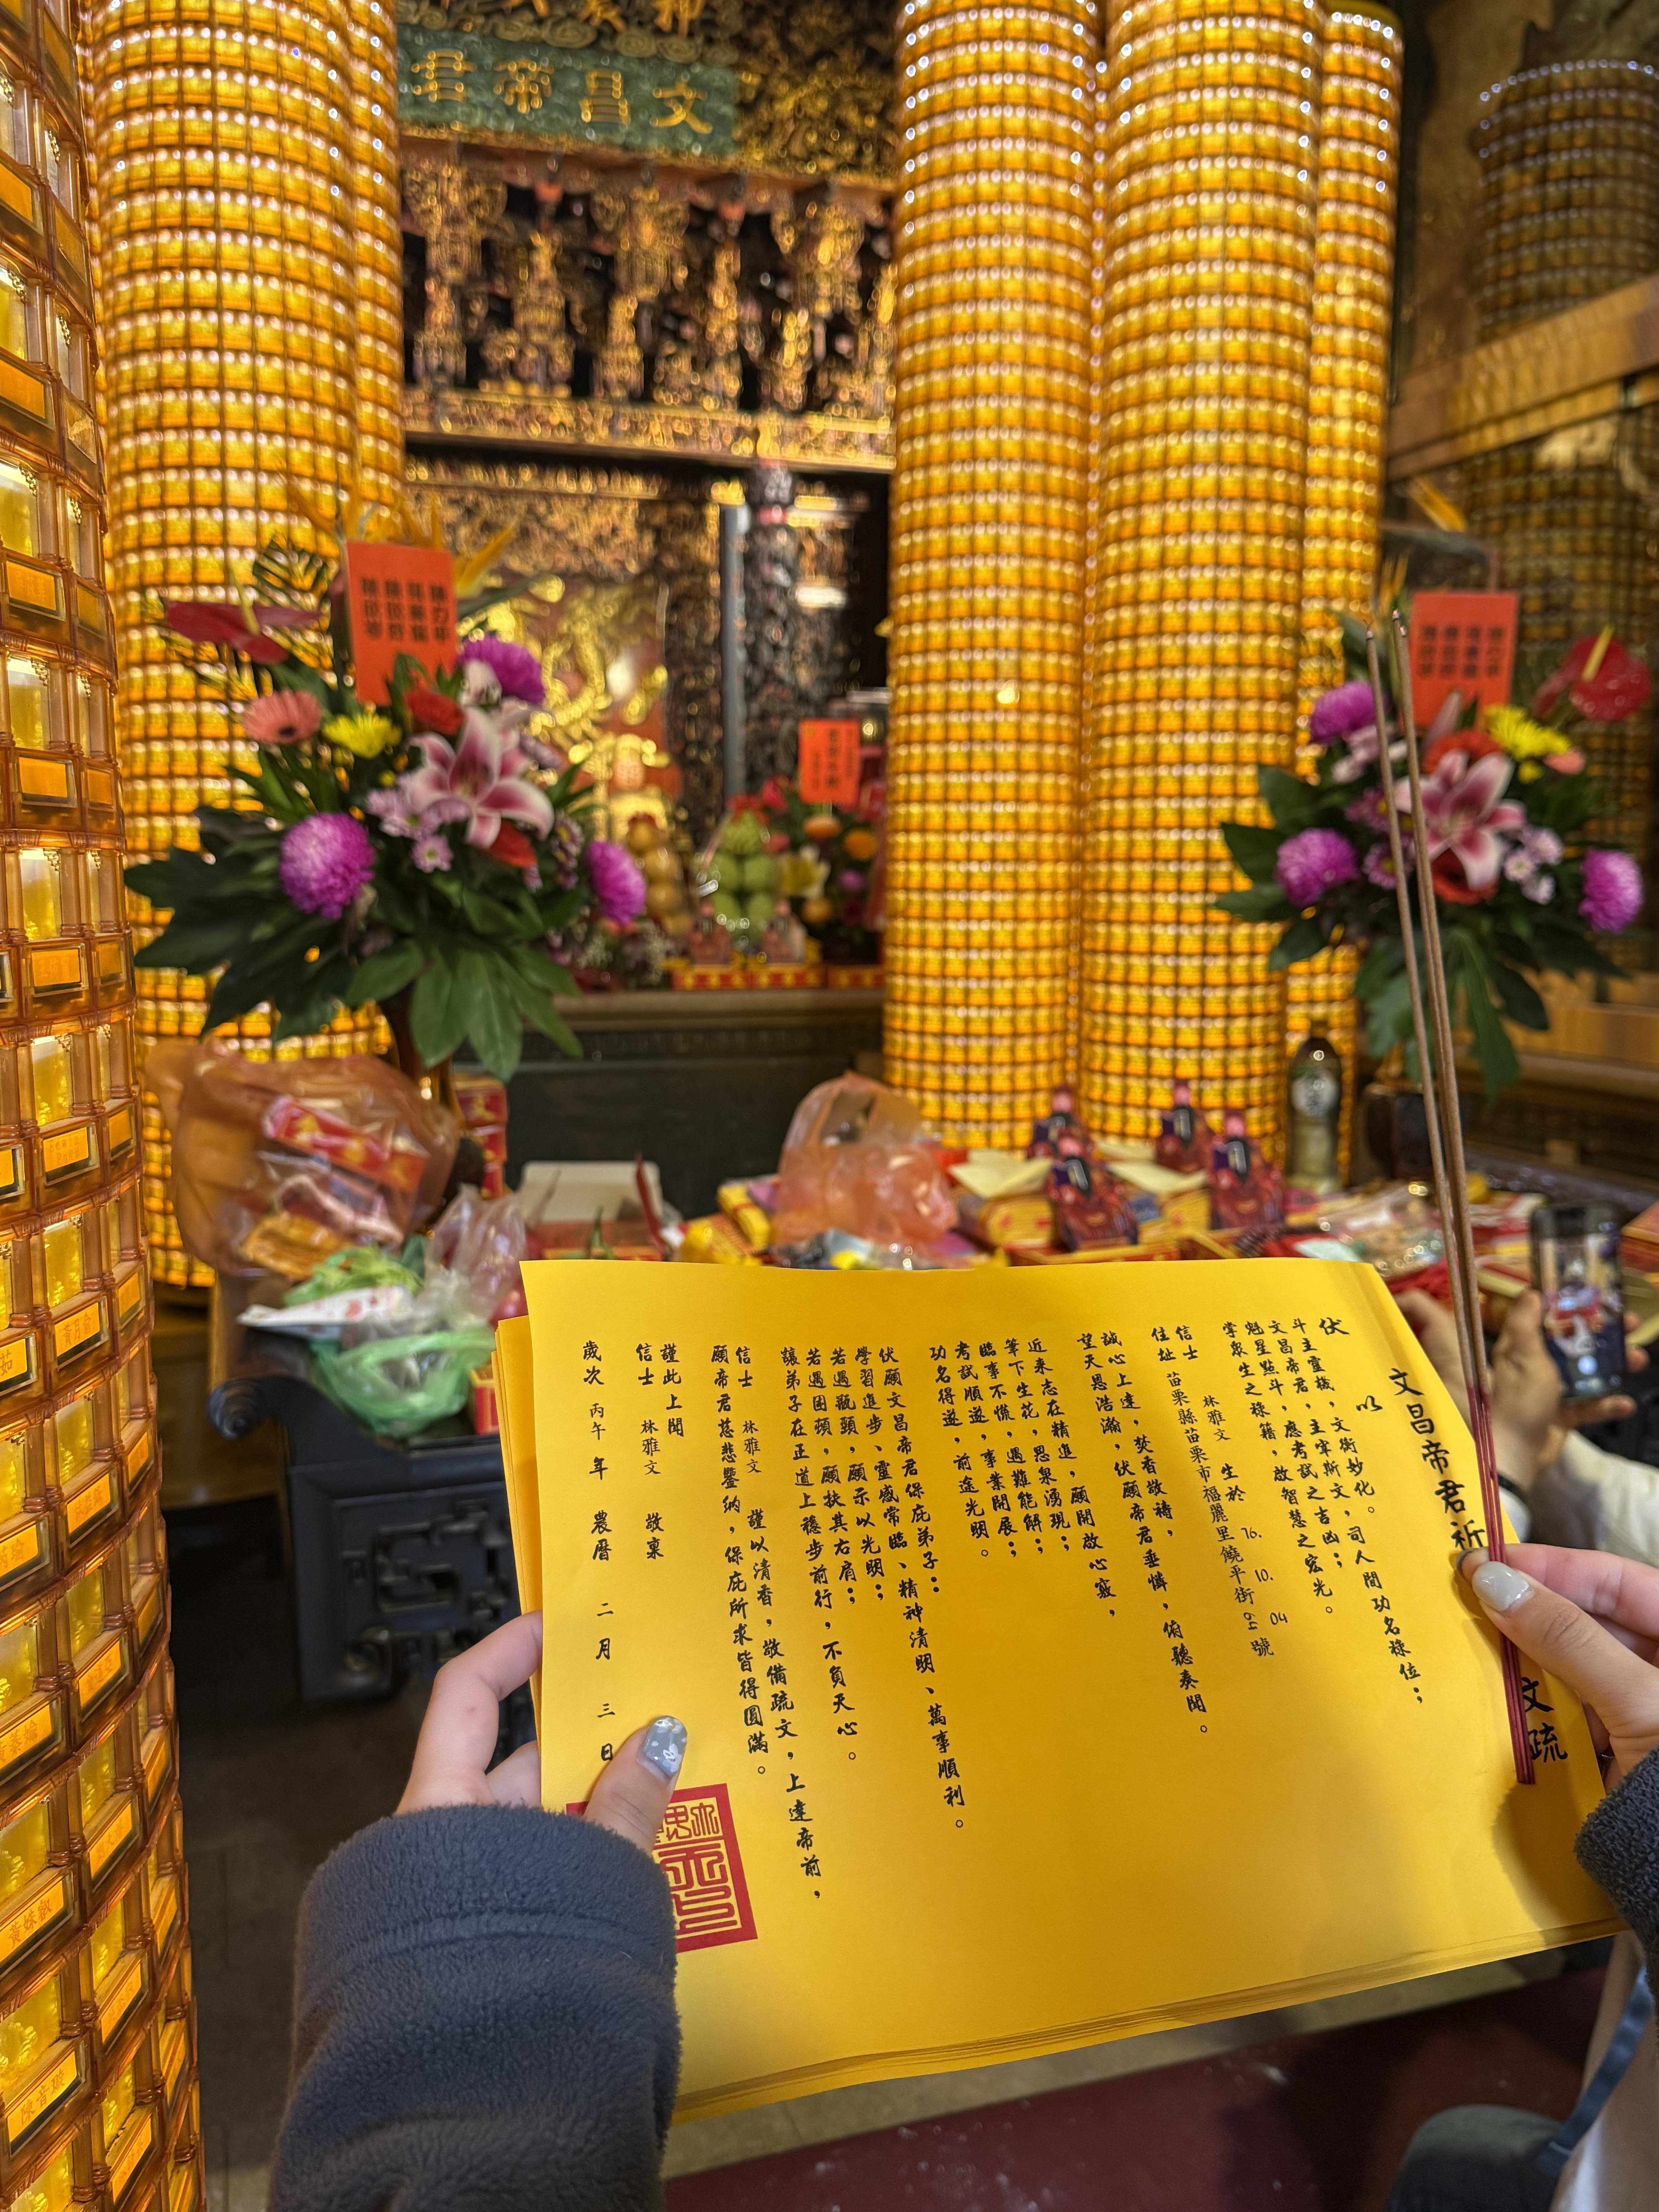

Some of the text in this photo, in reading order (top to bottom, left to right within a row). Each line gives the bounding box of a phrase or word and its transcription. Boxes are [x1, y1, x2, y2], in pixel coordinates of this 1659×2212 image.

[411, 50, 713, 134] 文昌帝君
[660, 1343, 684, 1437] 謹此上聞
[735, 1346, 753, 1388] 信士
[1151, 1327, 1176, 1362] 住址
[1319, 1317, 1383, 1412] 伏 以
[635, 1343, 665, 1559] 信士 林雅文 敬稟
[742, 1420, 761, 1473] 林雅文
[1175, 1325, 1198, 1360] 信士
[1203, 1395, 1230, 1441] 林雅文
[1221, 1463, 1246, 1502] 生於
[583, 1340, 615, 1761] 歲次 丙午 年 農曆 二 月 三 日
